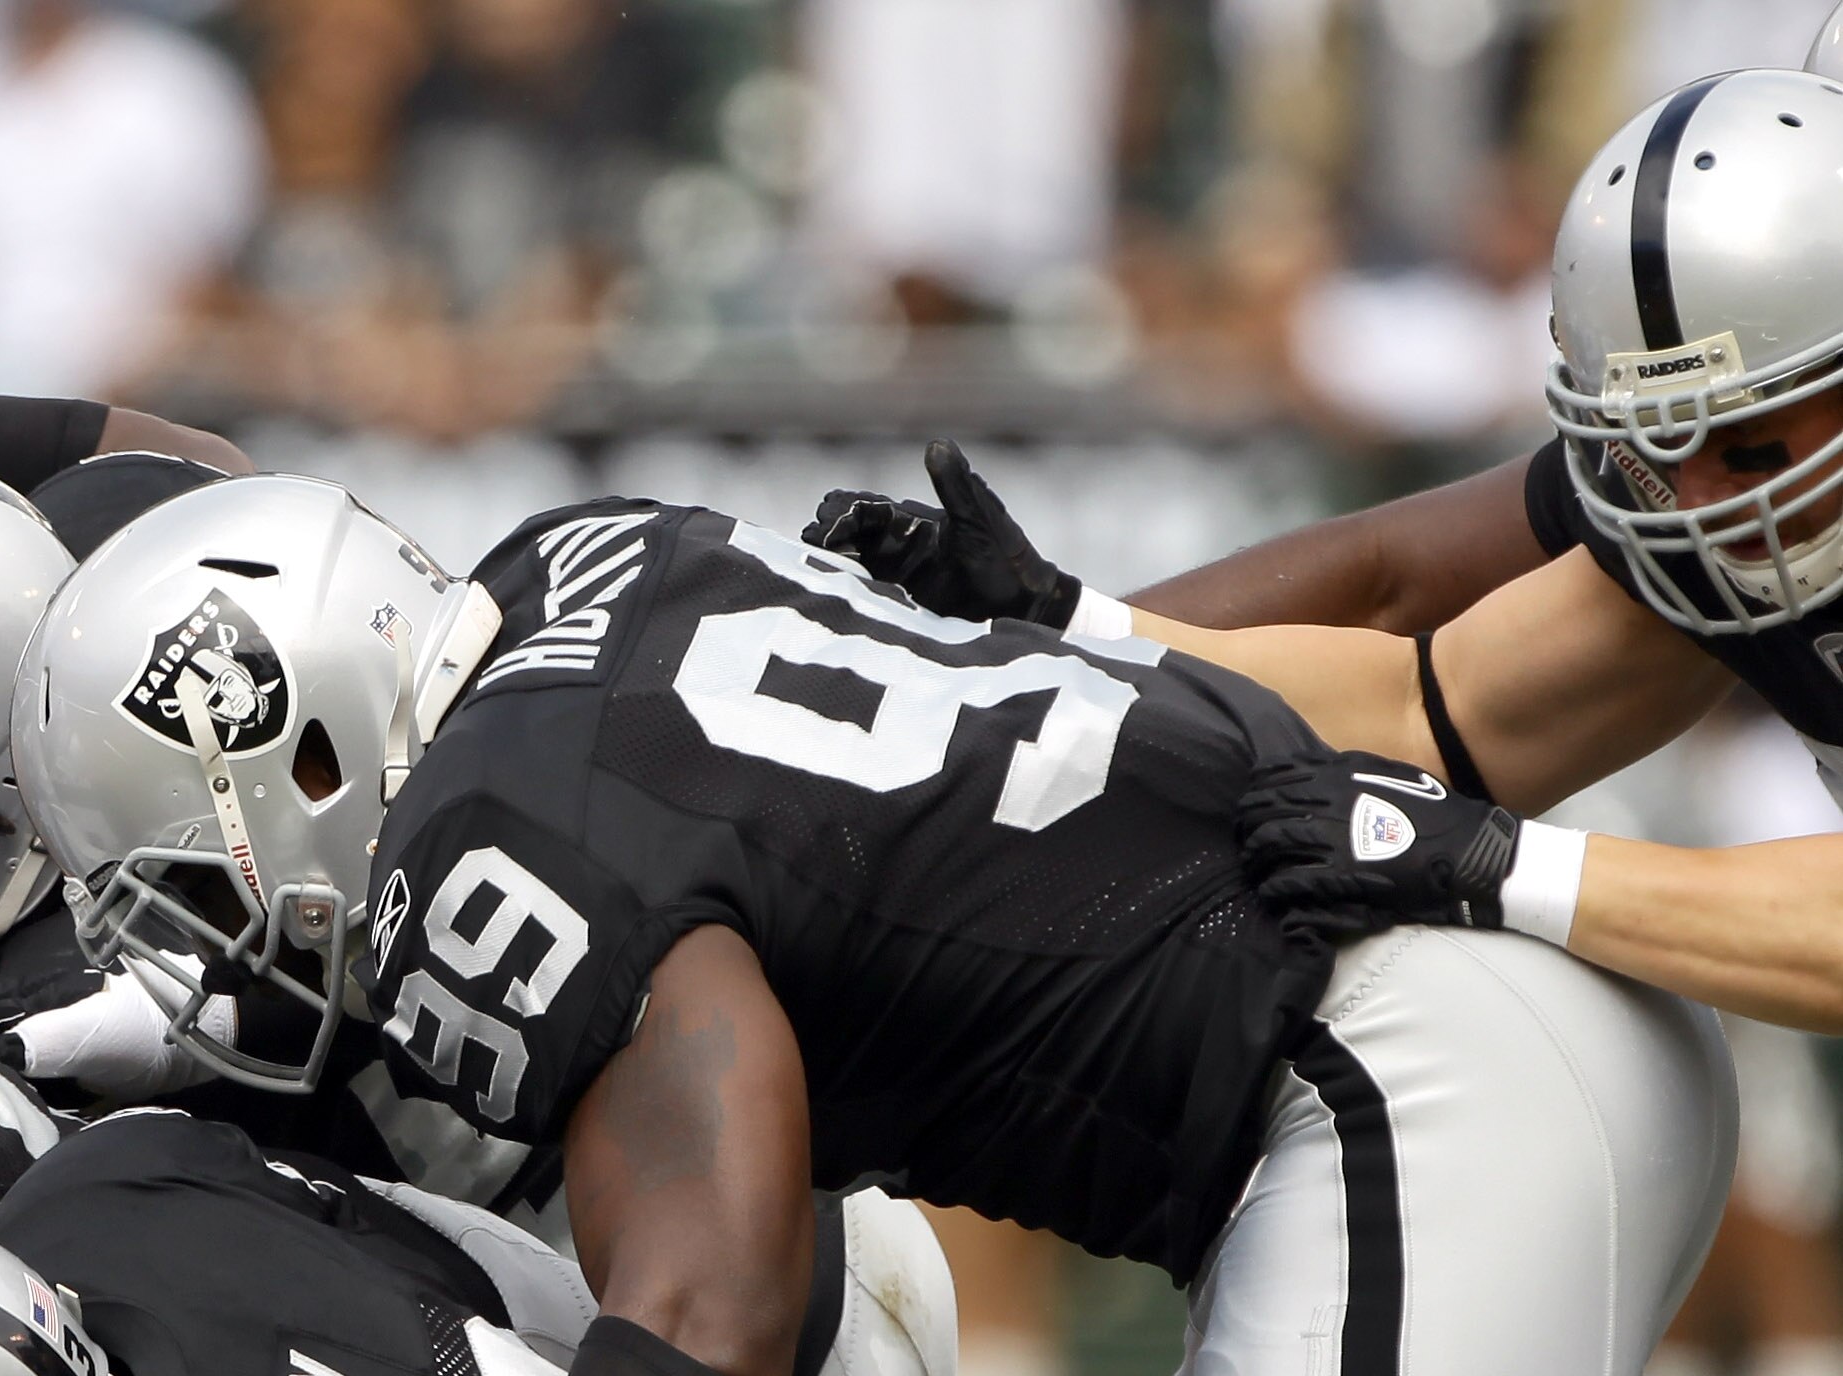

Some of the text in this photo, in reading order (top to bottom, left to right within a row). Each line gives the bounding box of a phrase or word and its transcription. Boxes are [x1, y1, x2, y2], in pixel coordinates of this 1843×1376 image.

[1637, 353, 1706, 380] RAIDERS
[133, 600, 220, 706] RAIDERS
[383, 845, 591, 1124] 99
